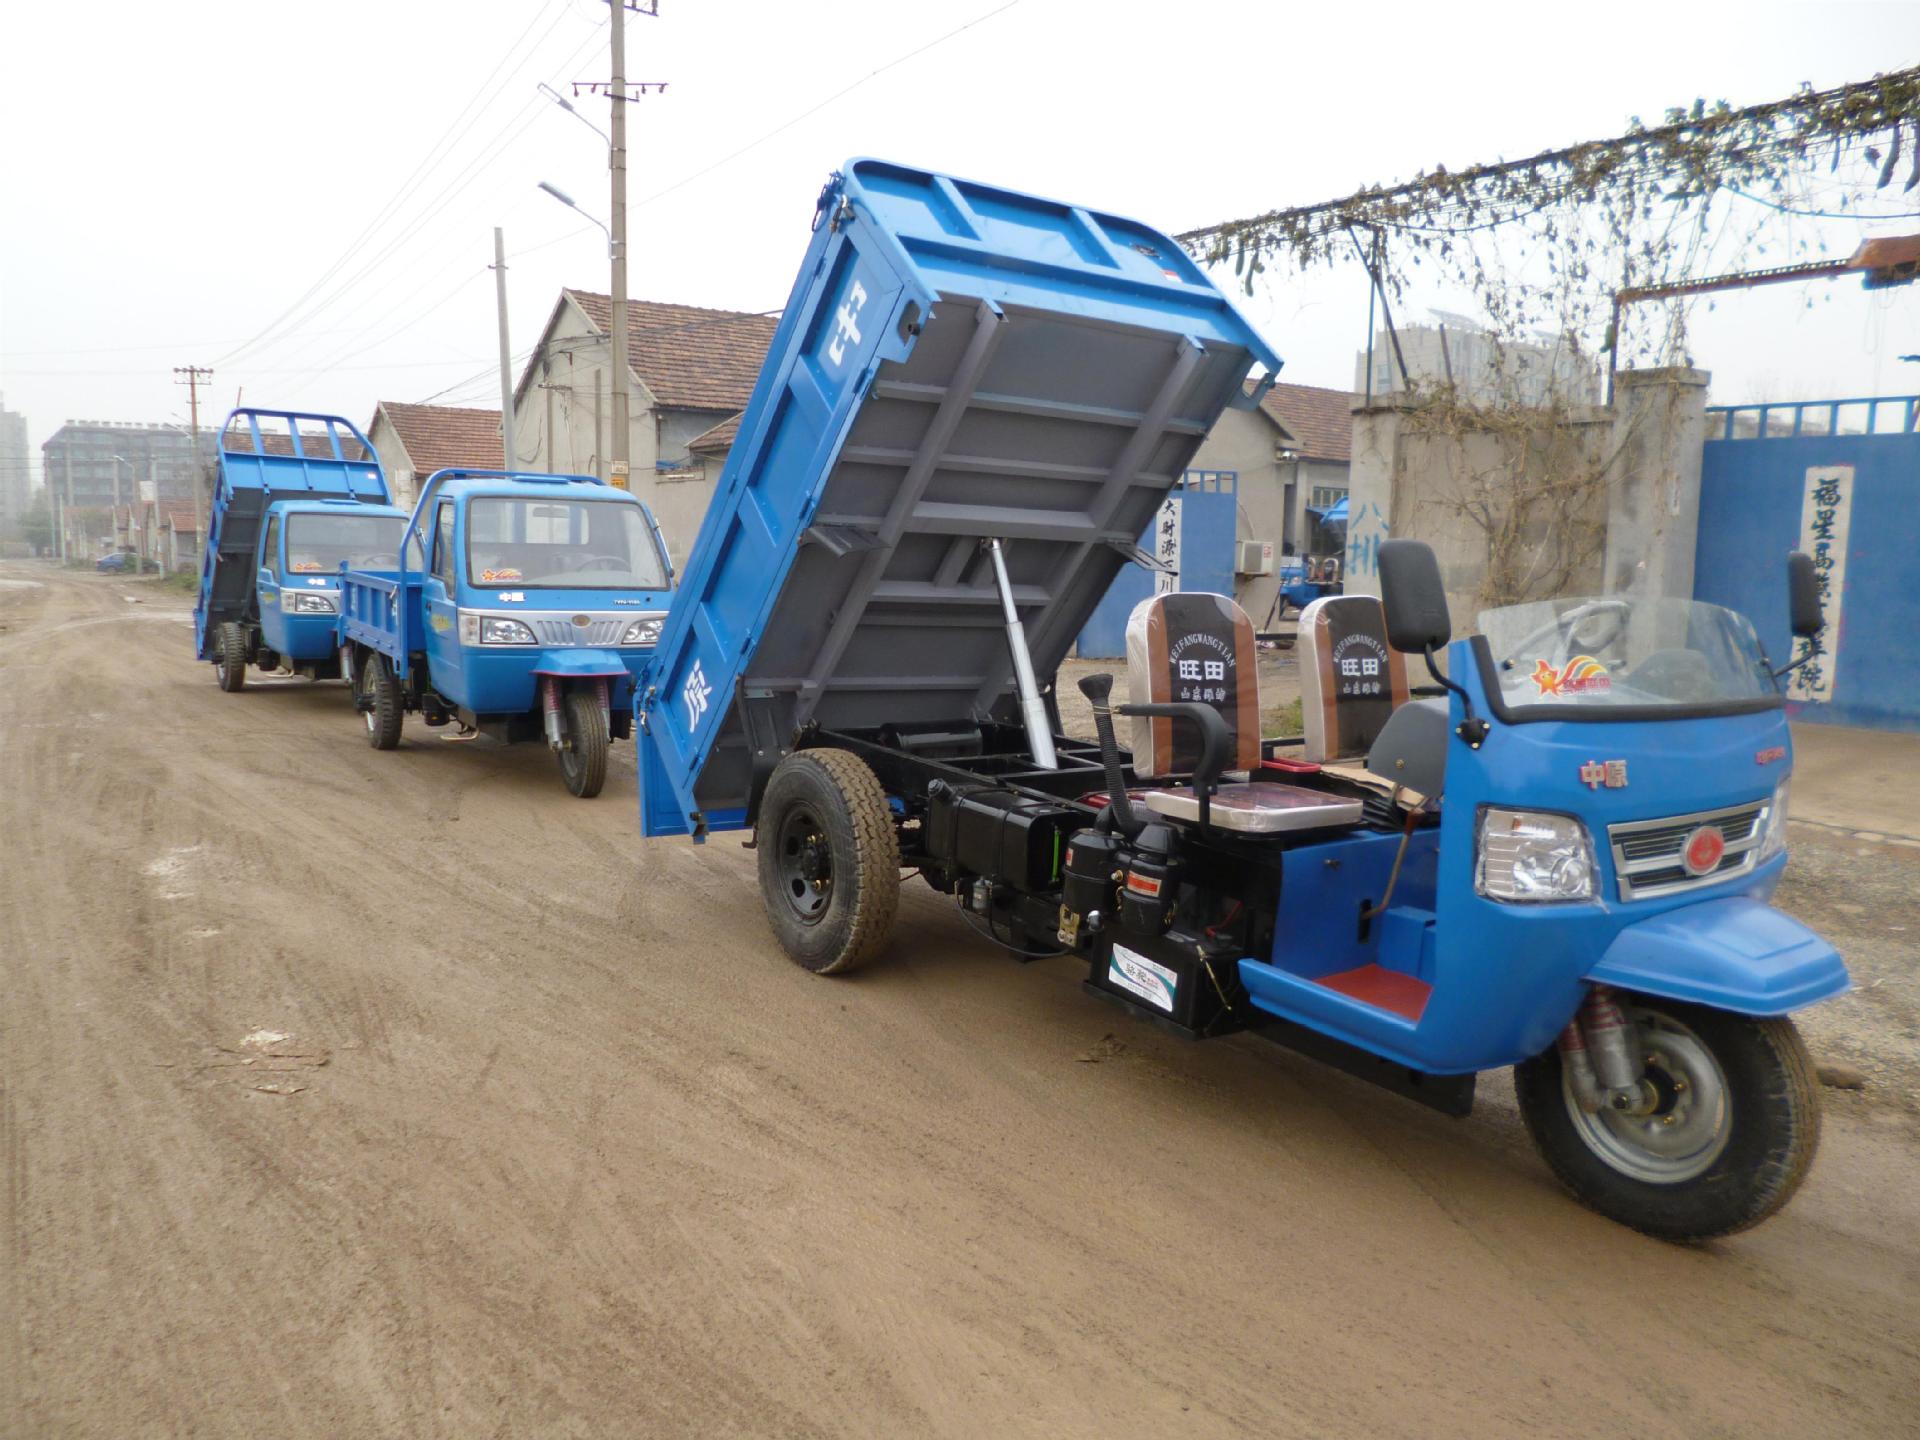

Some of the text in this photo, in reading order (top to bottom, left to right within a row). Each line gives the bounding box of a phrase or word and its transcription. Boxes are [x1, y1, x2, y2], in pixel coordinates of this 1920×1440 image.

[1179, 659, 1224, 681] 旺田
[1341, 658, 1379, 676] 旺田
[1579, 759, 1628, 790] 中原
